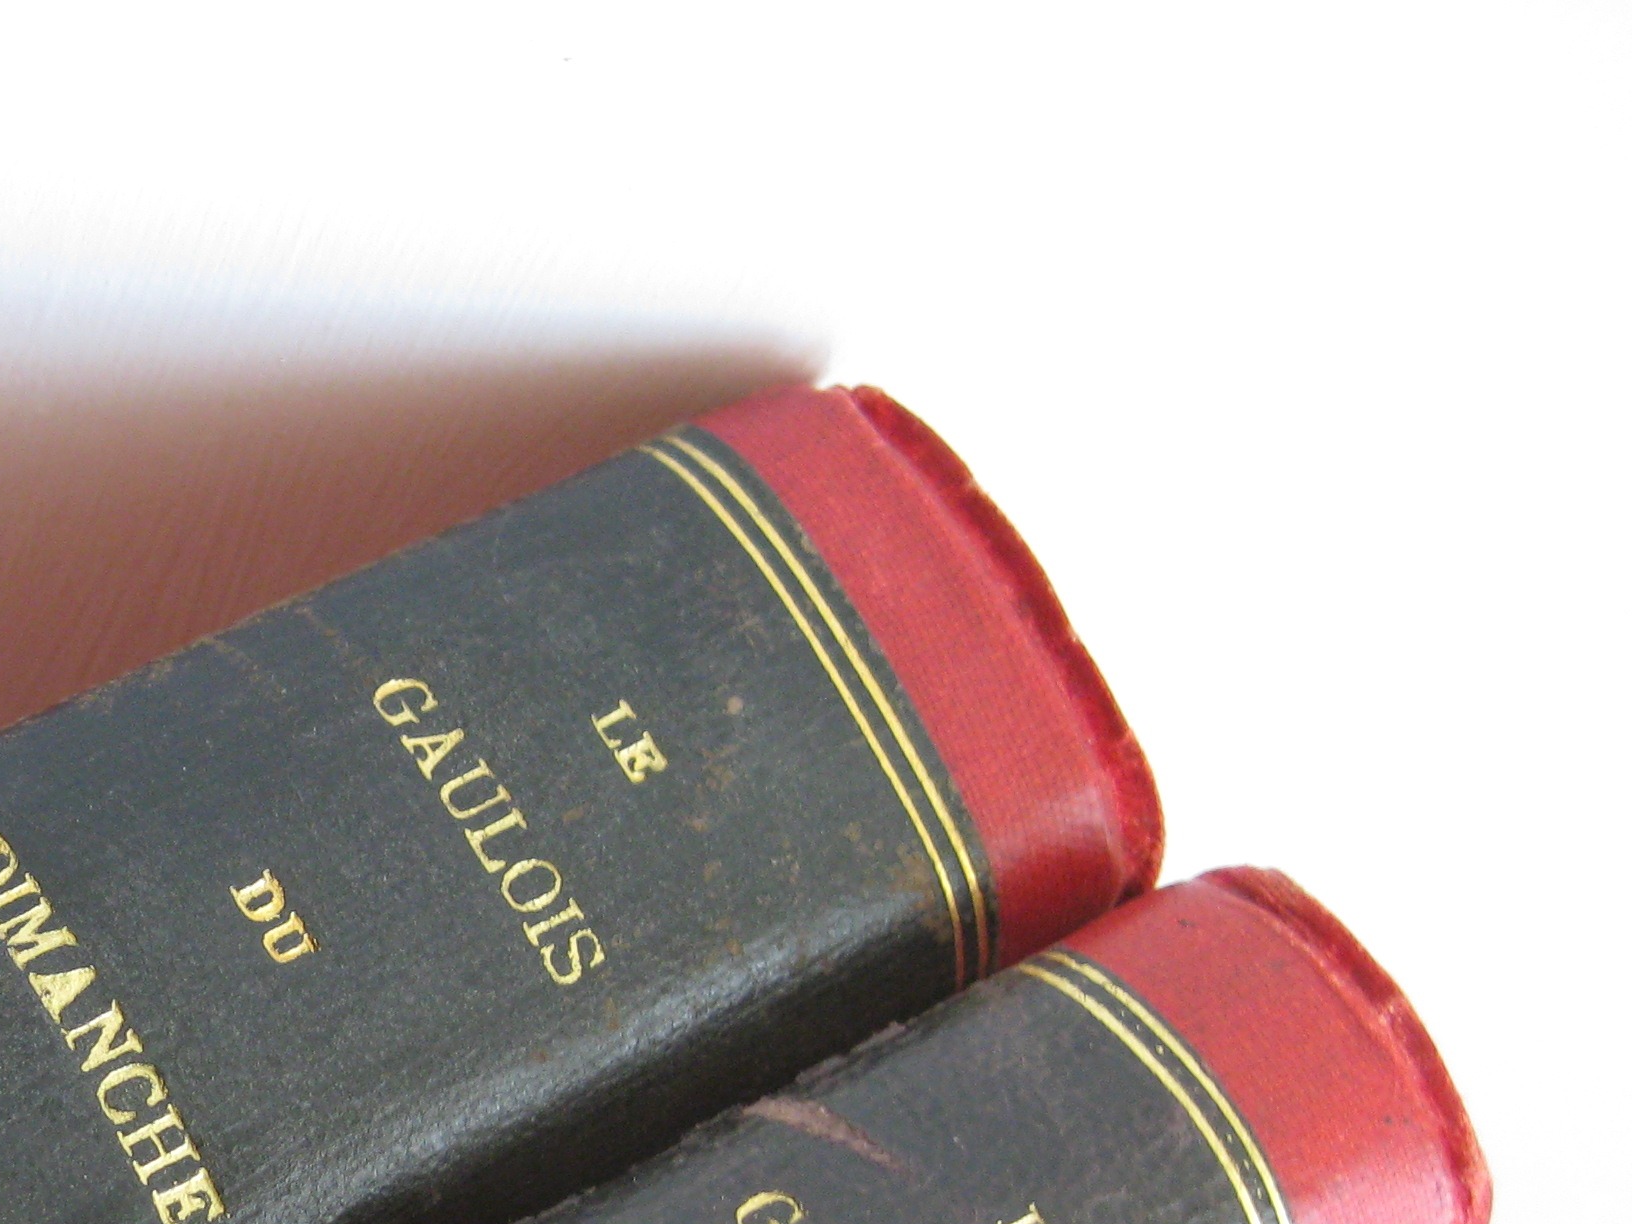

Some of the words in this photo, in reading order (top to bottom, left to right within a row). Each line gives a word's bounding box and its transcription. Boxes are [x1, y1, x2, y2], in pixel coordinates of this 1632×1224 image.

[591, 699, 669, 784] LE
[373, 677, 607, 987] GAULOIS
[230, 868, 319, 965] DU
